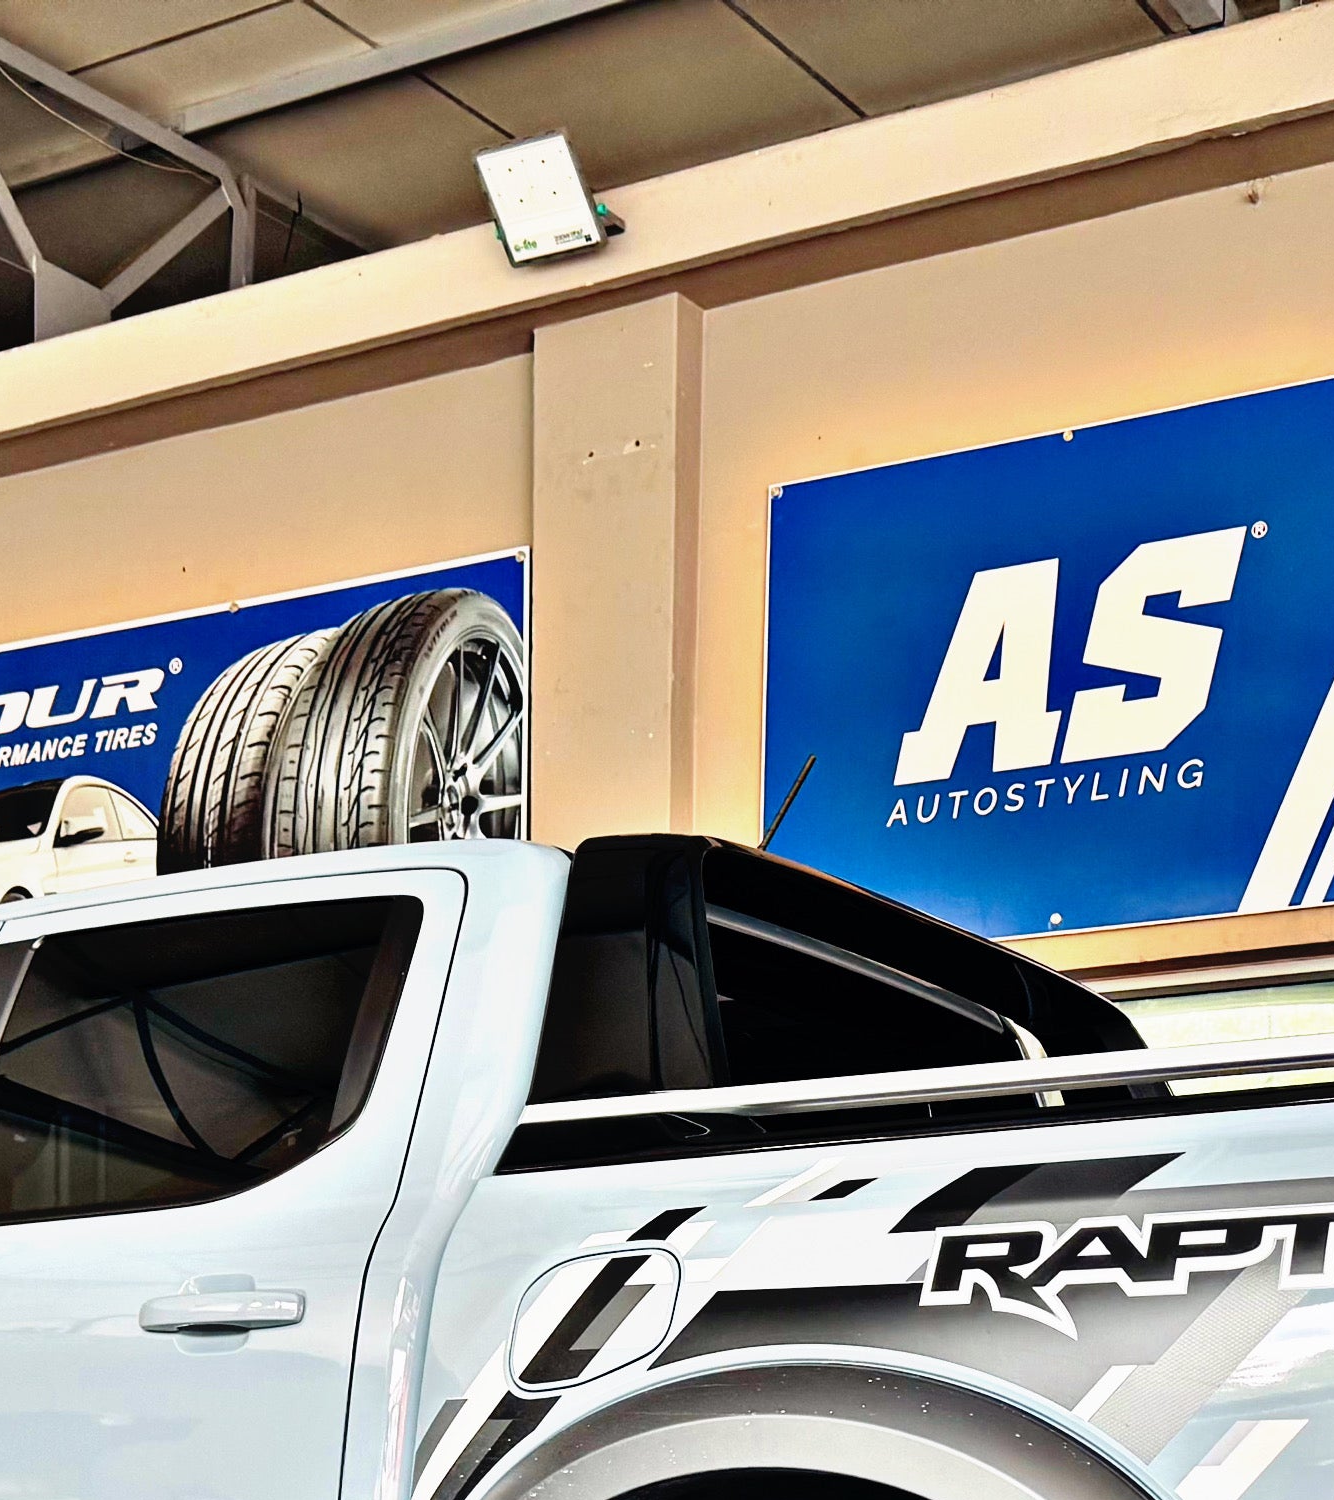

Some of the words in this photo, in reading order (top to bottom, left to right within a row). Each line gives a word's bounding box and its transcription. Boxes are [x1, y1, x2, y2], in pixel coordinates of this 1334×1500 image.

[893, 526, 1247, 786] AS
[94, 723, 158, 753] TIRES
[886, 758, 1204, 828] AUTOSTYLING
